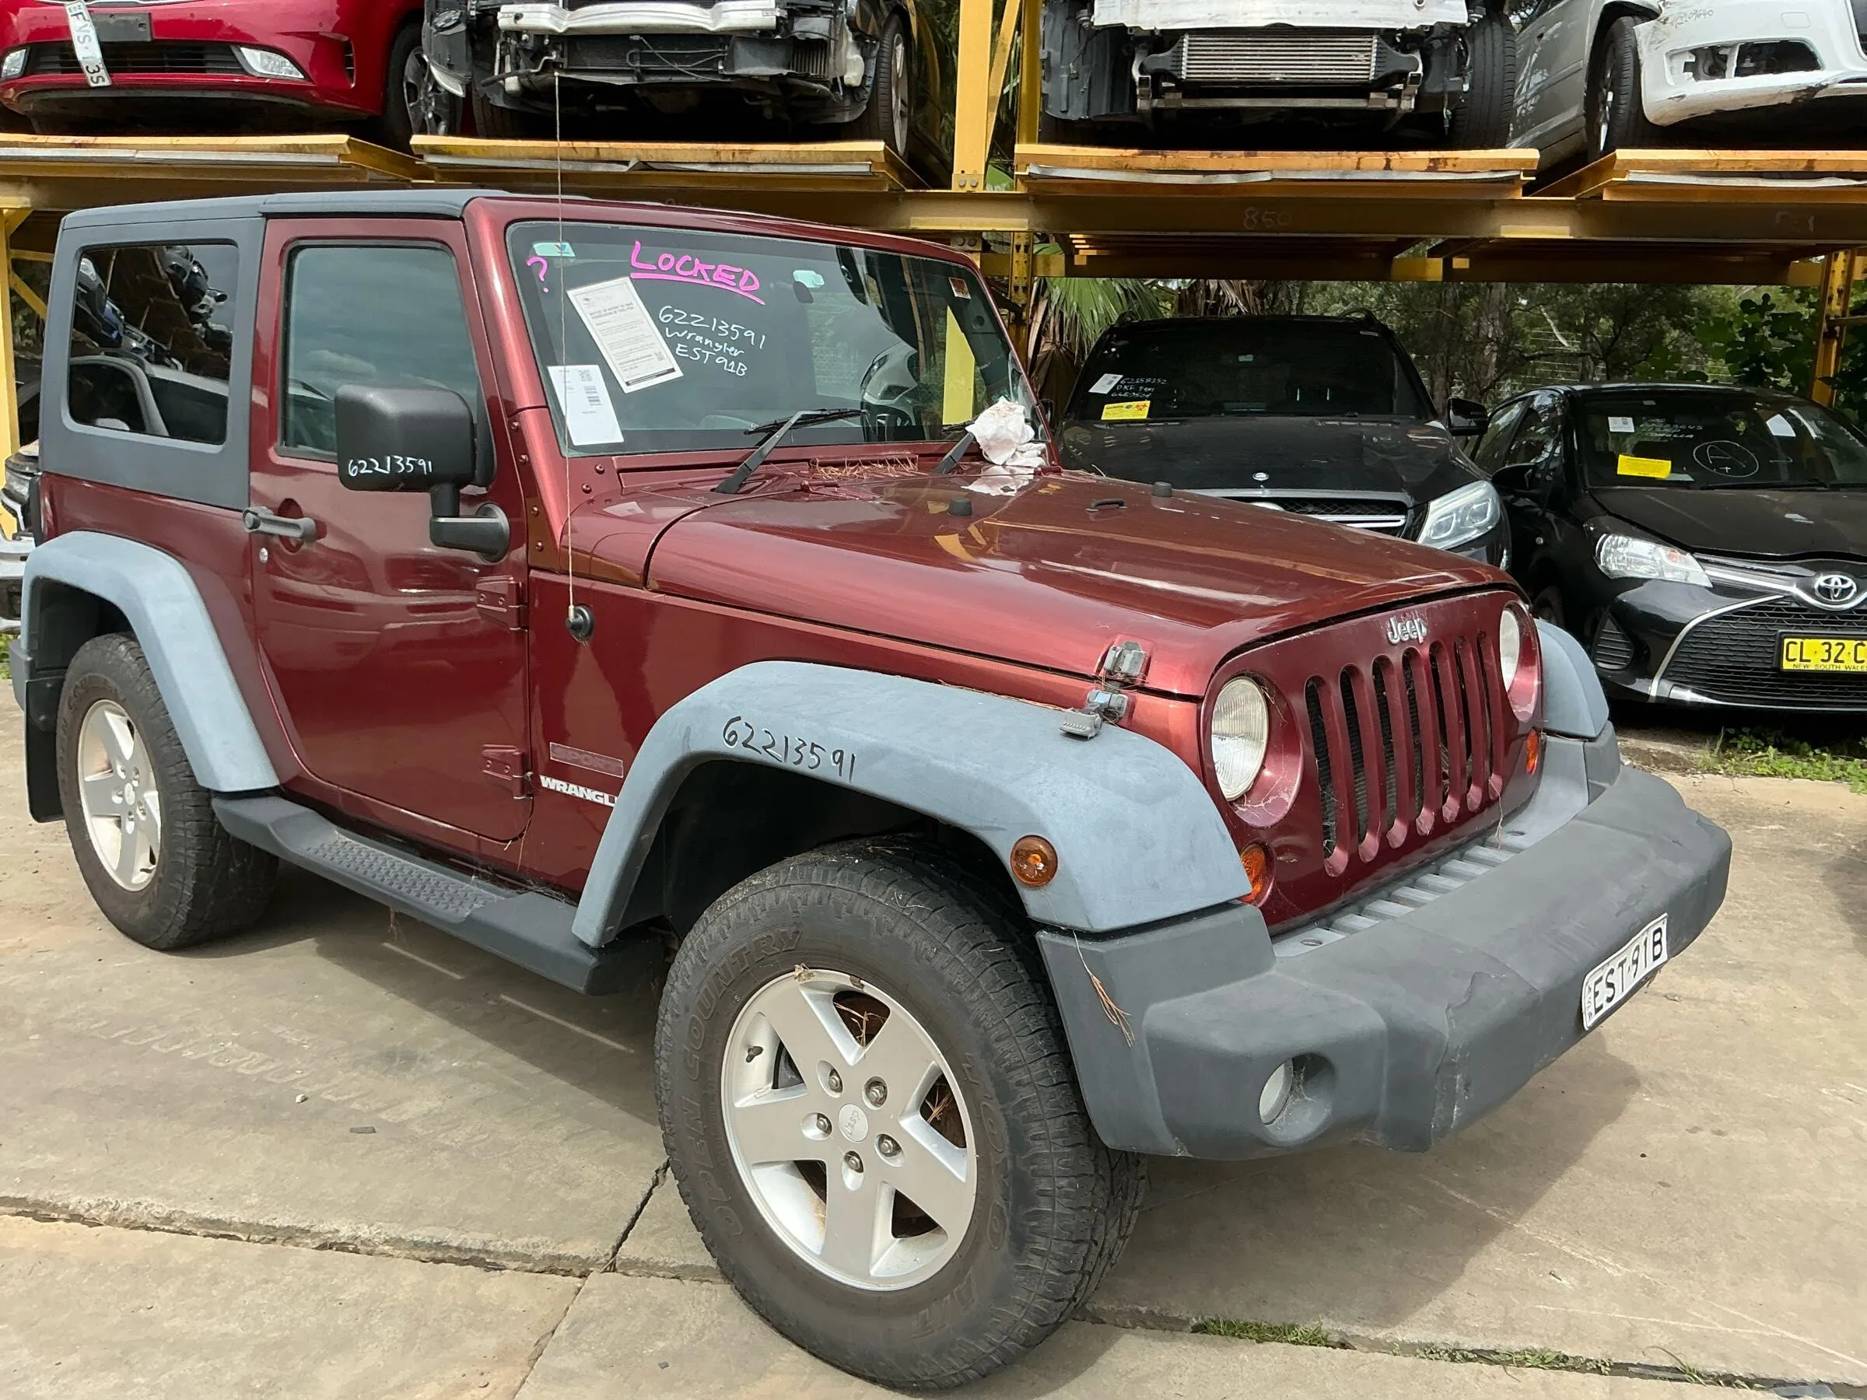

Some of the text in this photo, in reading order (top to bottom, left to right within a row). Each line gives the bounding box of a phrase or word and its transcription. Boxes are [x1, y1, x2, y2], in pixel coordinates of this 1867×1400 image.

[527, 256, 549, 293] ?
[630, 241, 760, 291] LOCKED
[659, 306, 765, 348] 62213591
[665, 327, 744, 356] Wrangler
[348, 456, 432, 477] 62213591
[1387, 616, 1427, 644] Jeep
[722, 716, 856, 780] 62213591
[539, 774, 618, 807] WRANGL
[687, 928, 802, 1081] COUNTRY
